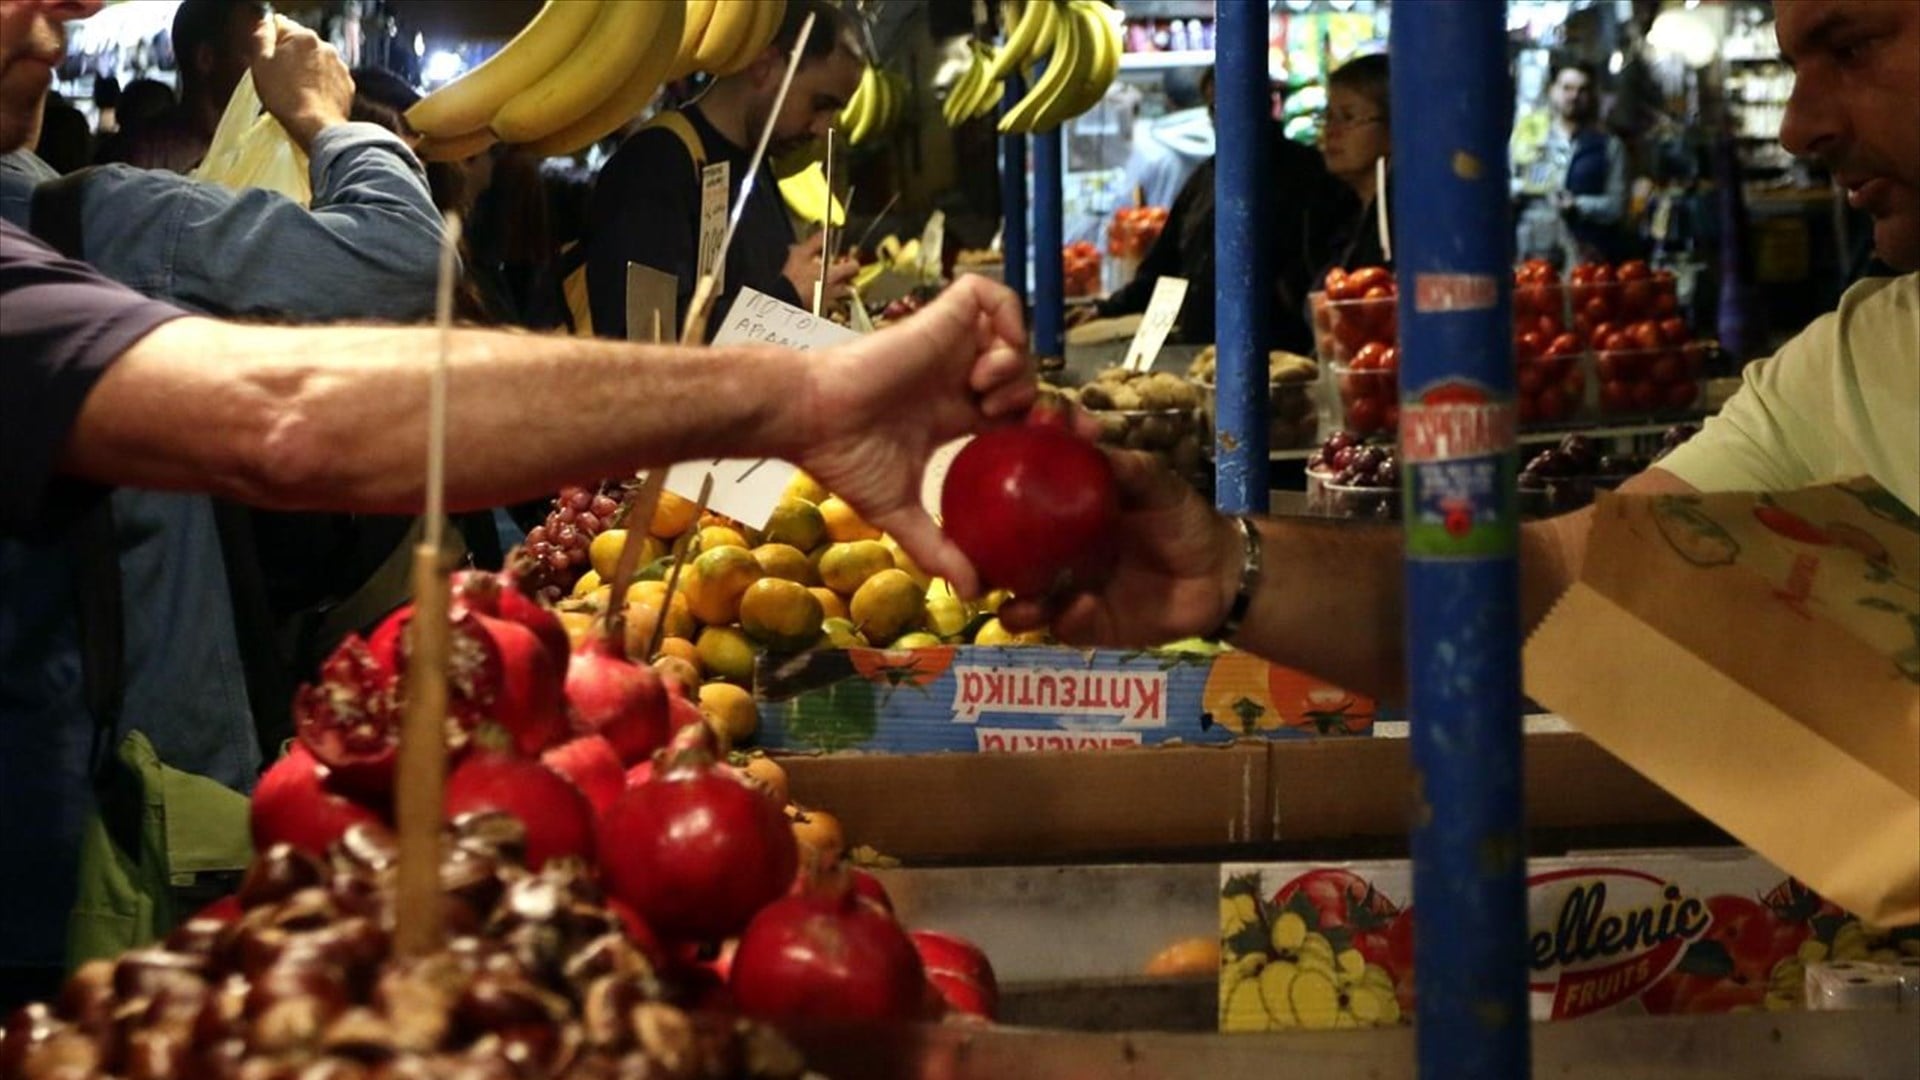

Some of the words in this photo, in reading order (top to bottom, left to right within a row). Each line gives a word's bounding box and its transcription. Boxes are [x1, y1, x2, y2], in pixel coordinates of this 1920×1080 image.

[962, 672, 1160, 719] Κηπευτικά
[1530, 880, 1710, 971] ellenic
[1563, 958, 1651, 1014] FRUITS
